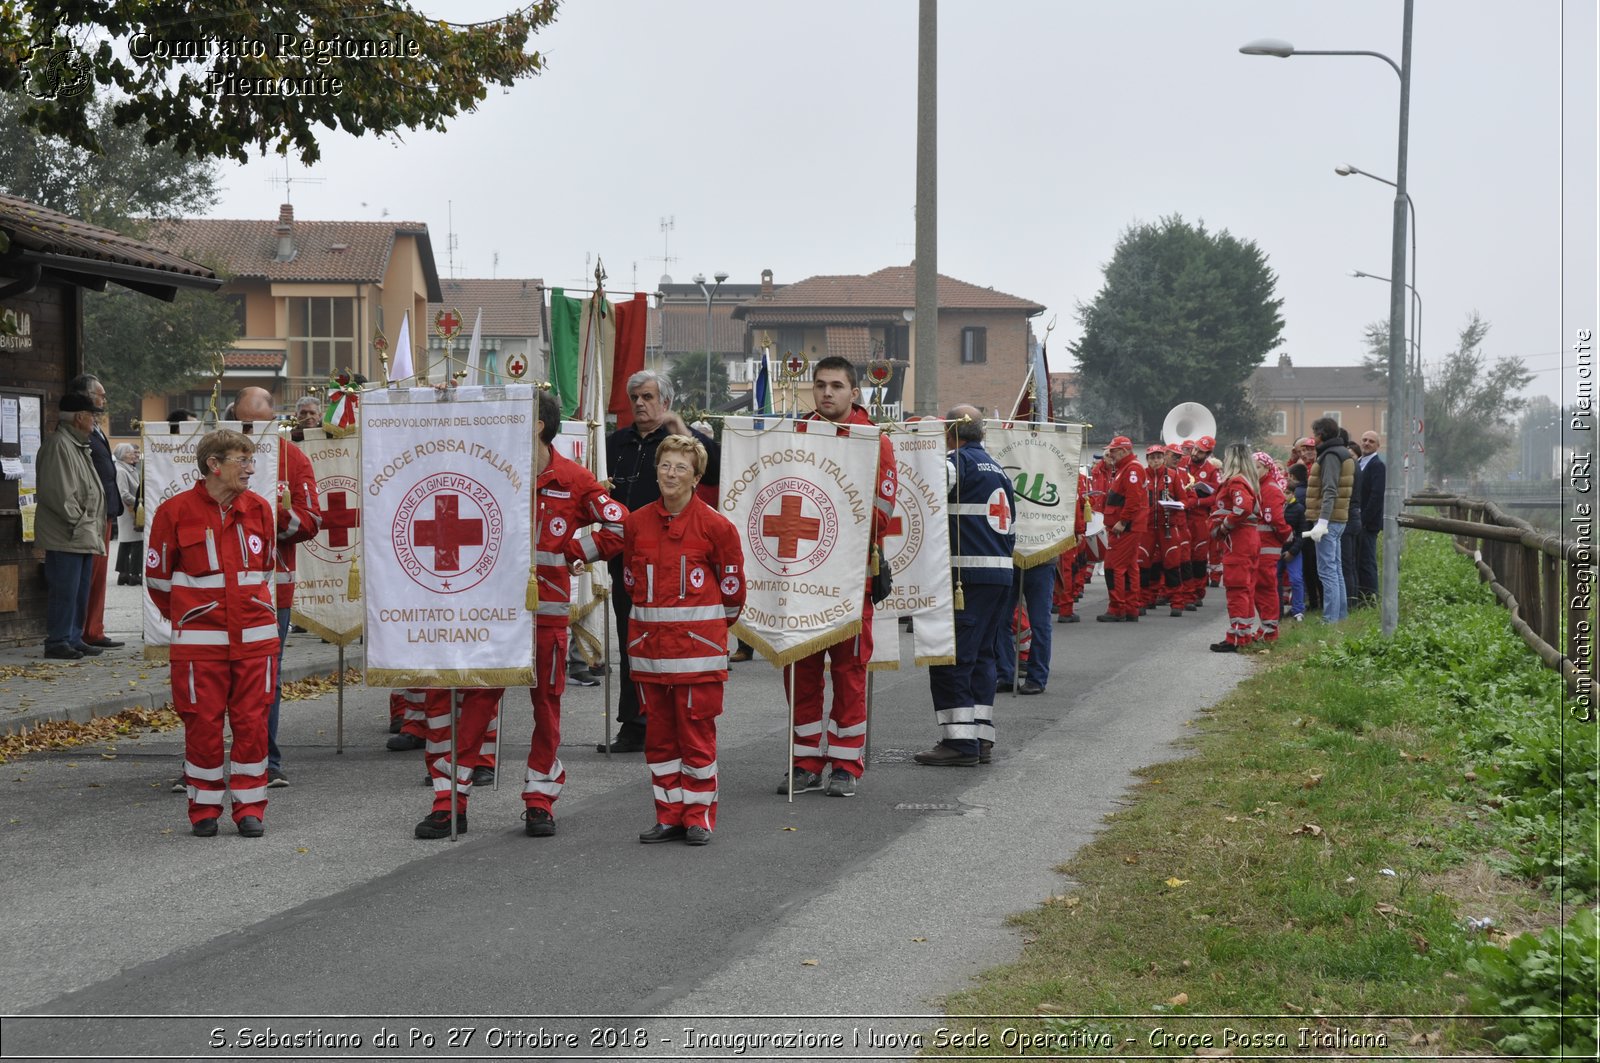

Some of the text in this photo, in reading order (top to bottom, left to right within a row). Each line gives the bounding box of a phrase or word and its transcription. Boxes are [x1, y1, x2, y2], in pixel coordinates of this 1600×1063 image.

[368, 414, 526, 428] CORPO VOLONTARI DEL SOCCORSO
[900, 440, 936, 452] SOCCORSO
[1025, 438, 1046, 448] DELLA
[1048, 444, 1066, 463] TERZA
[310, 448, 350, 462] ROSSA
[368, 439, 523, 496] CROCE ROSSA ITALIANA
[320, 478, 356, 490] GINEVRA
[723, 448, 867, 525] CROCE ROSSA ITALIANA
[904, 497, 916, 512] 22
[396, 476, 501, 577] CONVENZIONE DI GINEVRA 22 AGOSTO 1864
[750, 480, 836, 566] CONVENZIONE DI GINEVRA 22 AGOSTO 1864
[906, 513, 920, 554] AGOSTO
[1046, 532, 1056, 540] DA
[1056, 525, 1066, 536] PO
[792, 582, 840, 598] LOCALE
[909, 586, 920, 594] DI
[778, 598, 787, 606] DI
[380, 608, 516, 622] COMITATO LOCALE
[778, 598, 855, 628] TORINESE
[408, 628, 490, 642] LAURIANO
